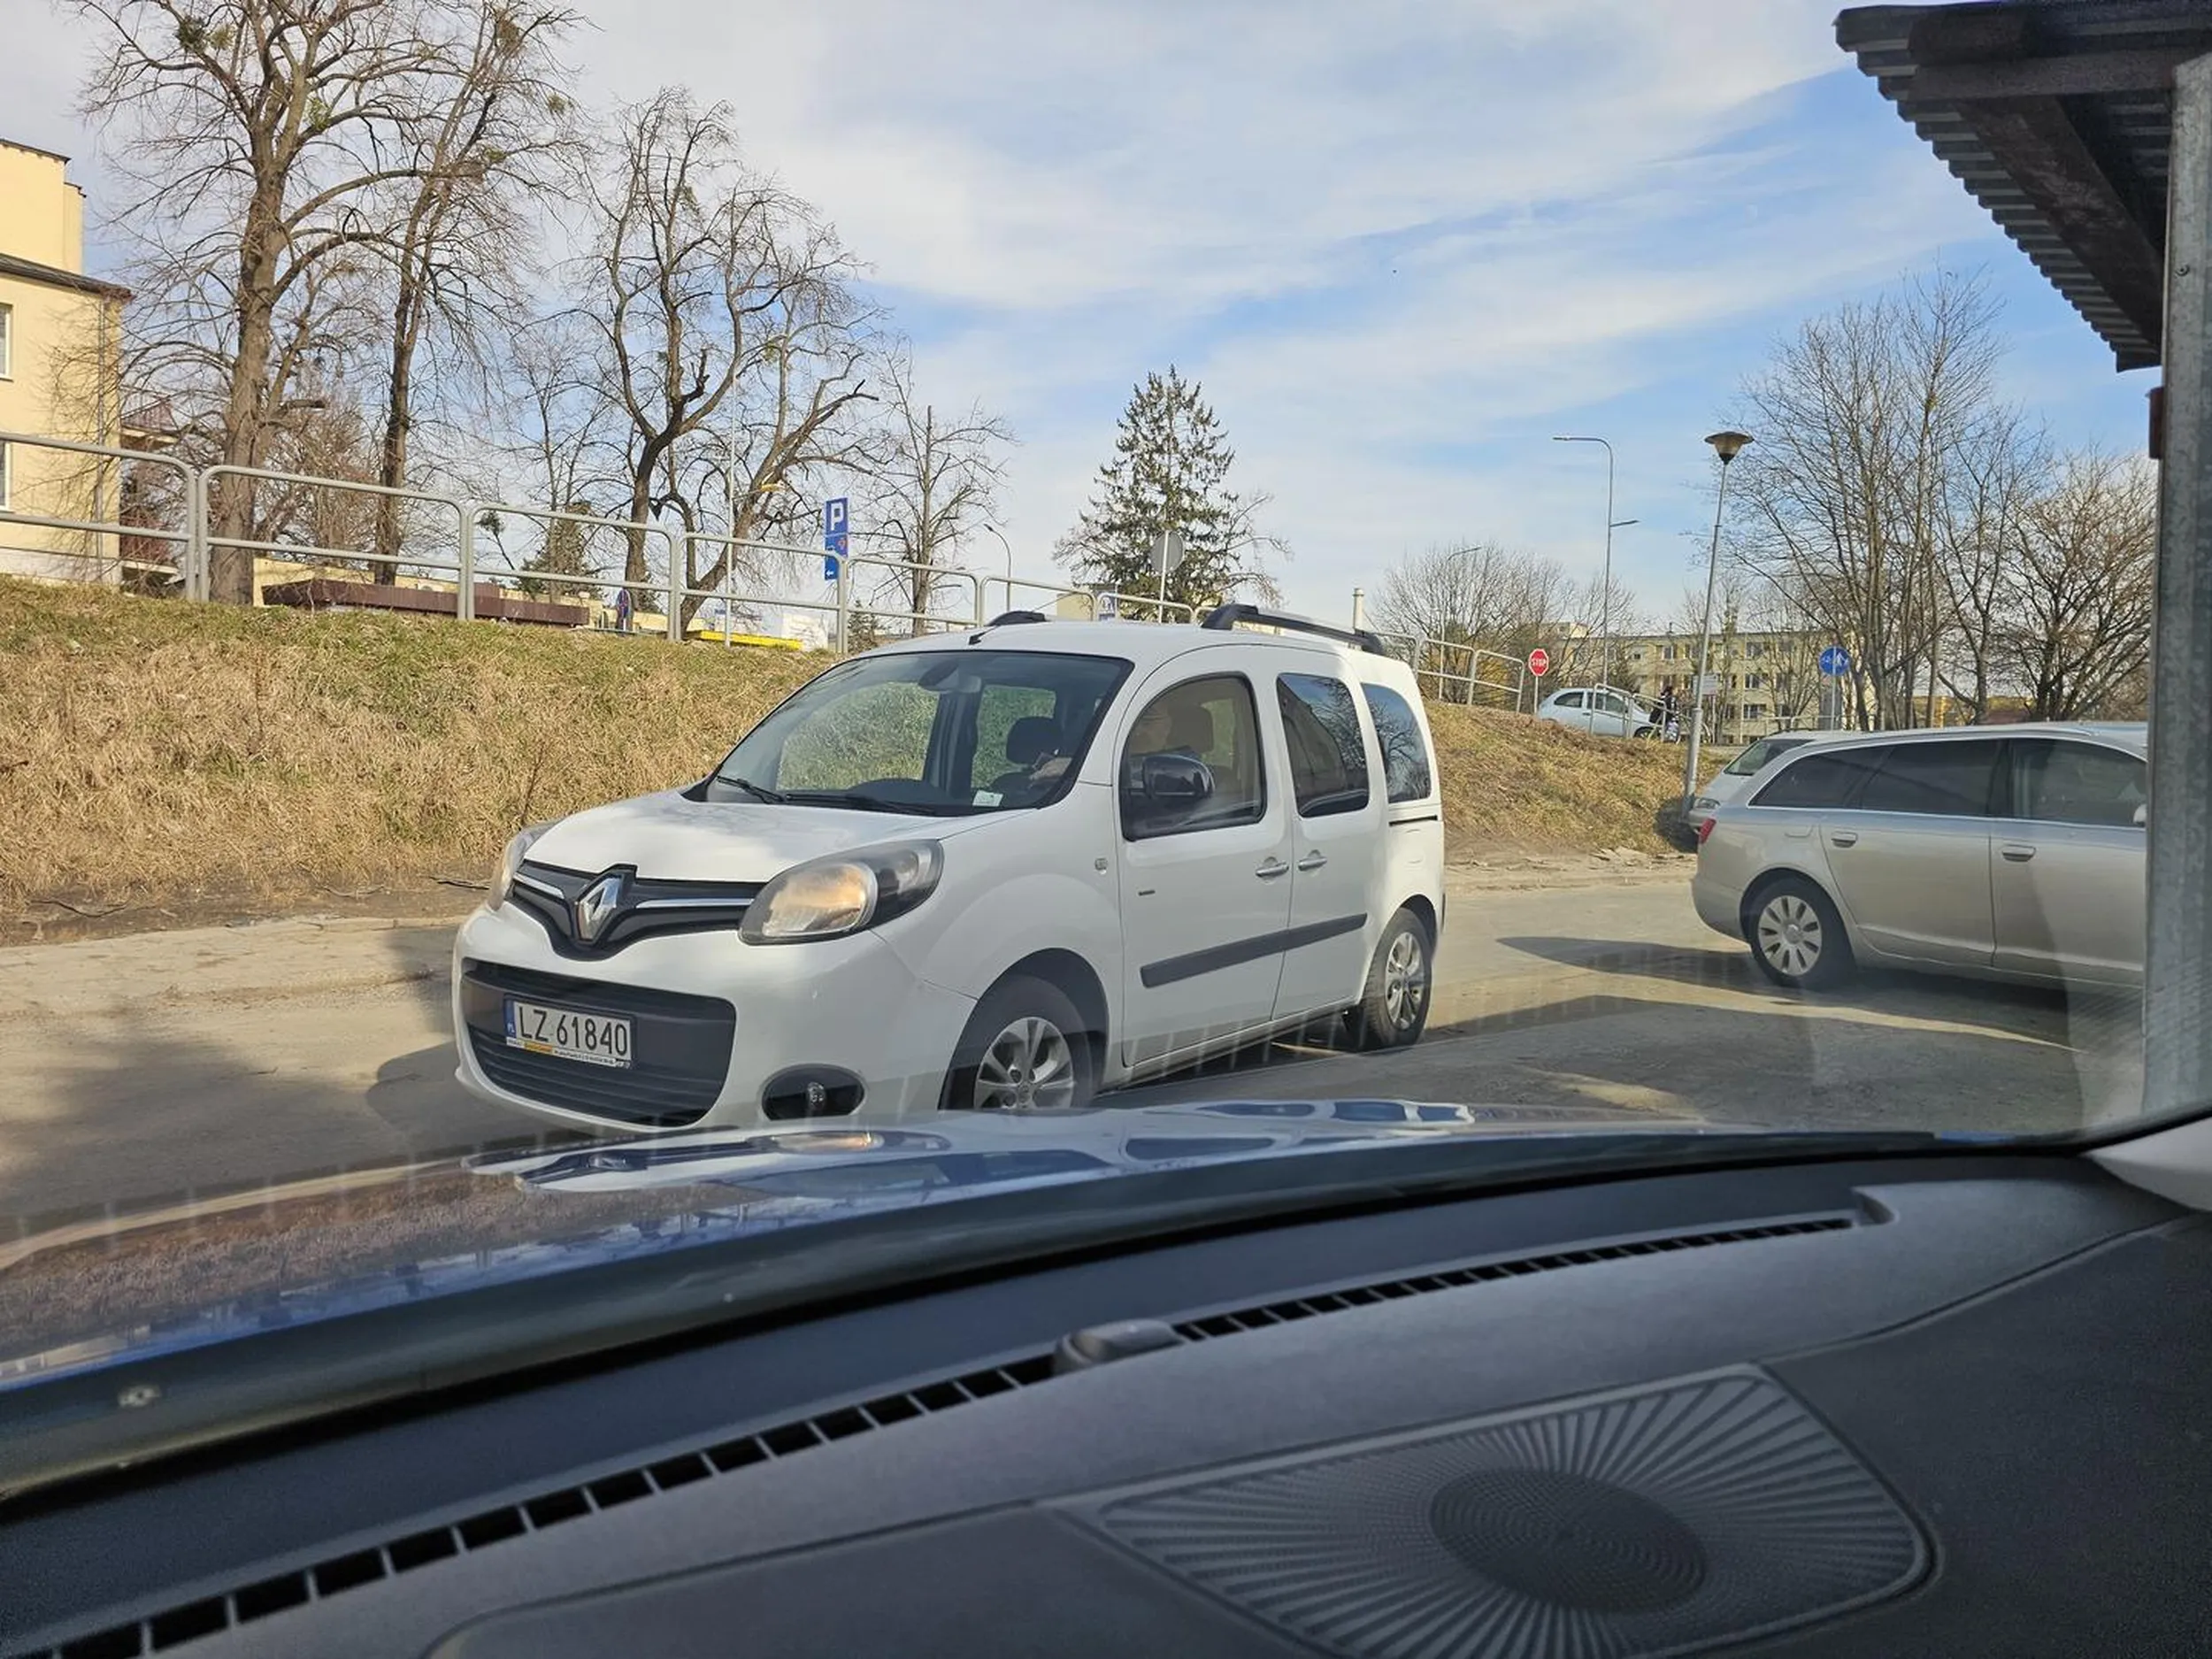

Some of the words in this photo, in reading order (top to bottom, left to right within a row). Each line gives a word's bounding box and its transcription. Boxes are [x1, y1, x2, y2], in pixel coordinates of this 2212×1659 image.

[830, 502, 844, 531] P
[1531, 657, 1547, 666] STOP
[518, 1006, 549, 1042] LZ
[557, 1014, 627, 1056] 61840
